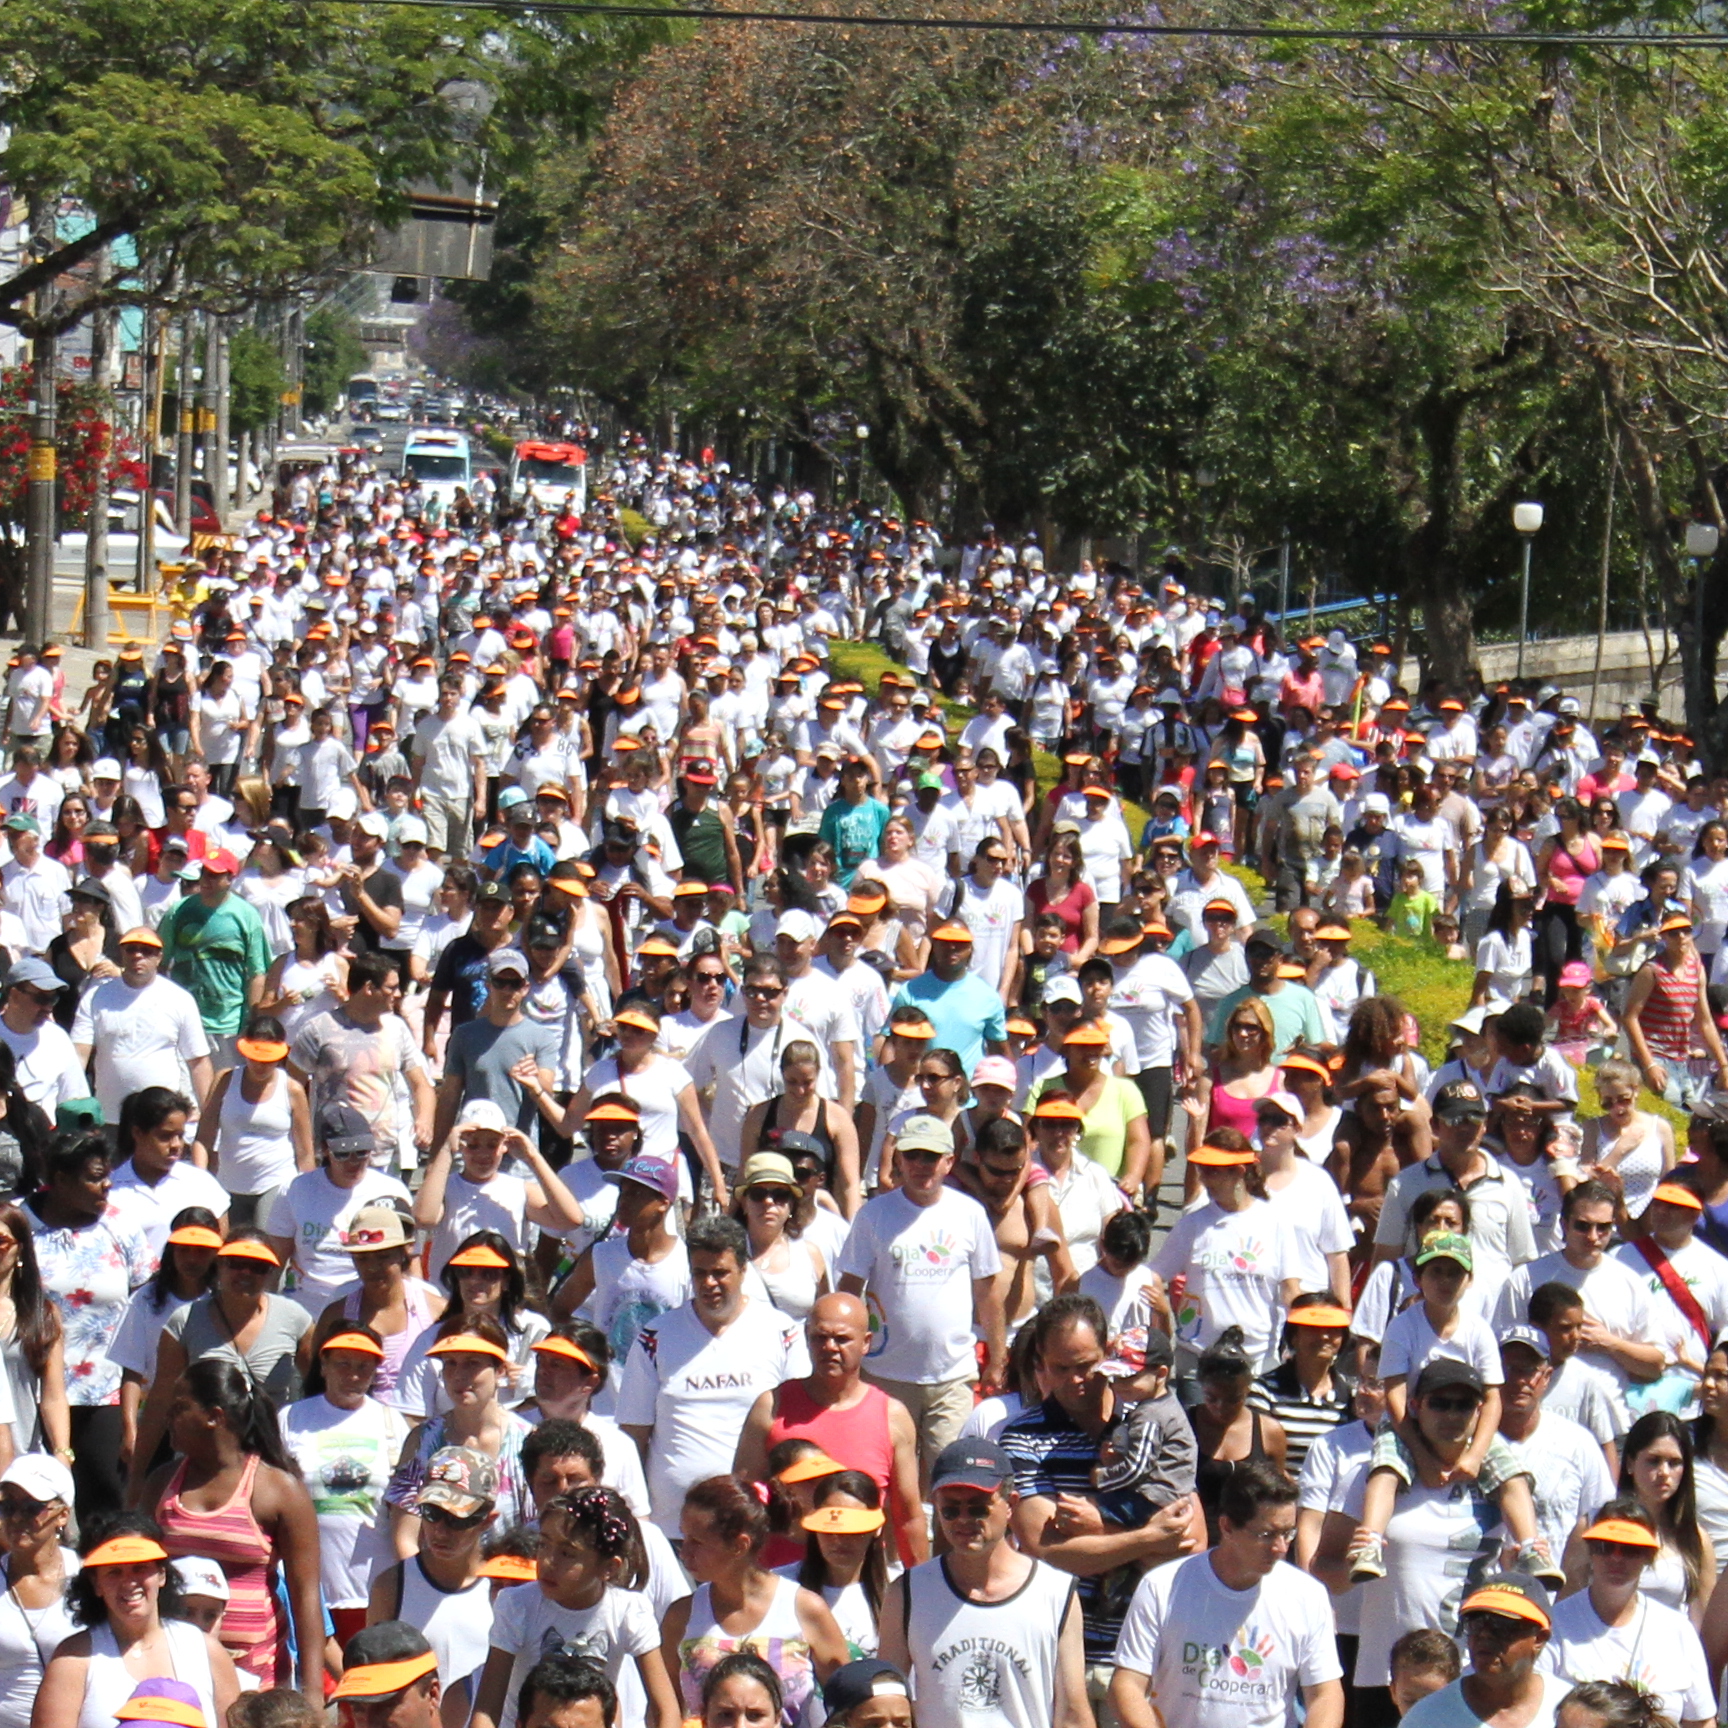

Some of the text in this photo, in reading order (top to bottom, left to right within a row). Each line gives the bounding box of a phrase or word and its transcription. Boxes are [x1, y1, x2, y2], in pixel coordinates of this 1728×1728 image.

[1499, 1324, 1540, 1343] FBI
[685, 1371, 753, 1393] NAFAR
[932, 1637, 1031, 1680] TRADITIONAL
[1183, 1641, 1221, 1665] Dia
[1198, 1668, 1271, 1698] Cooperar
